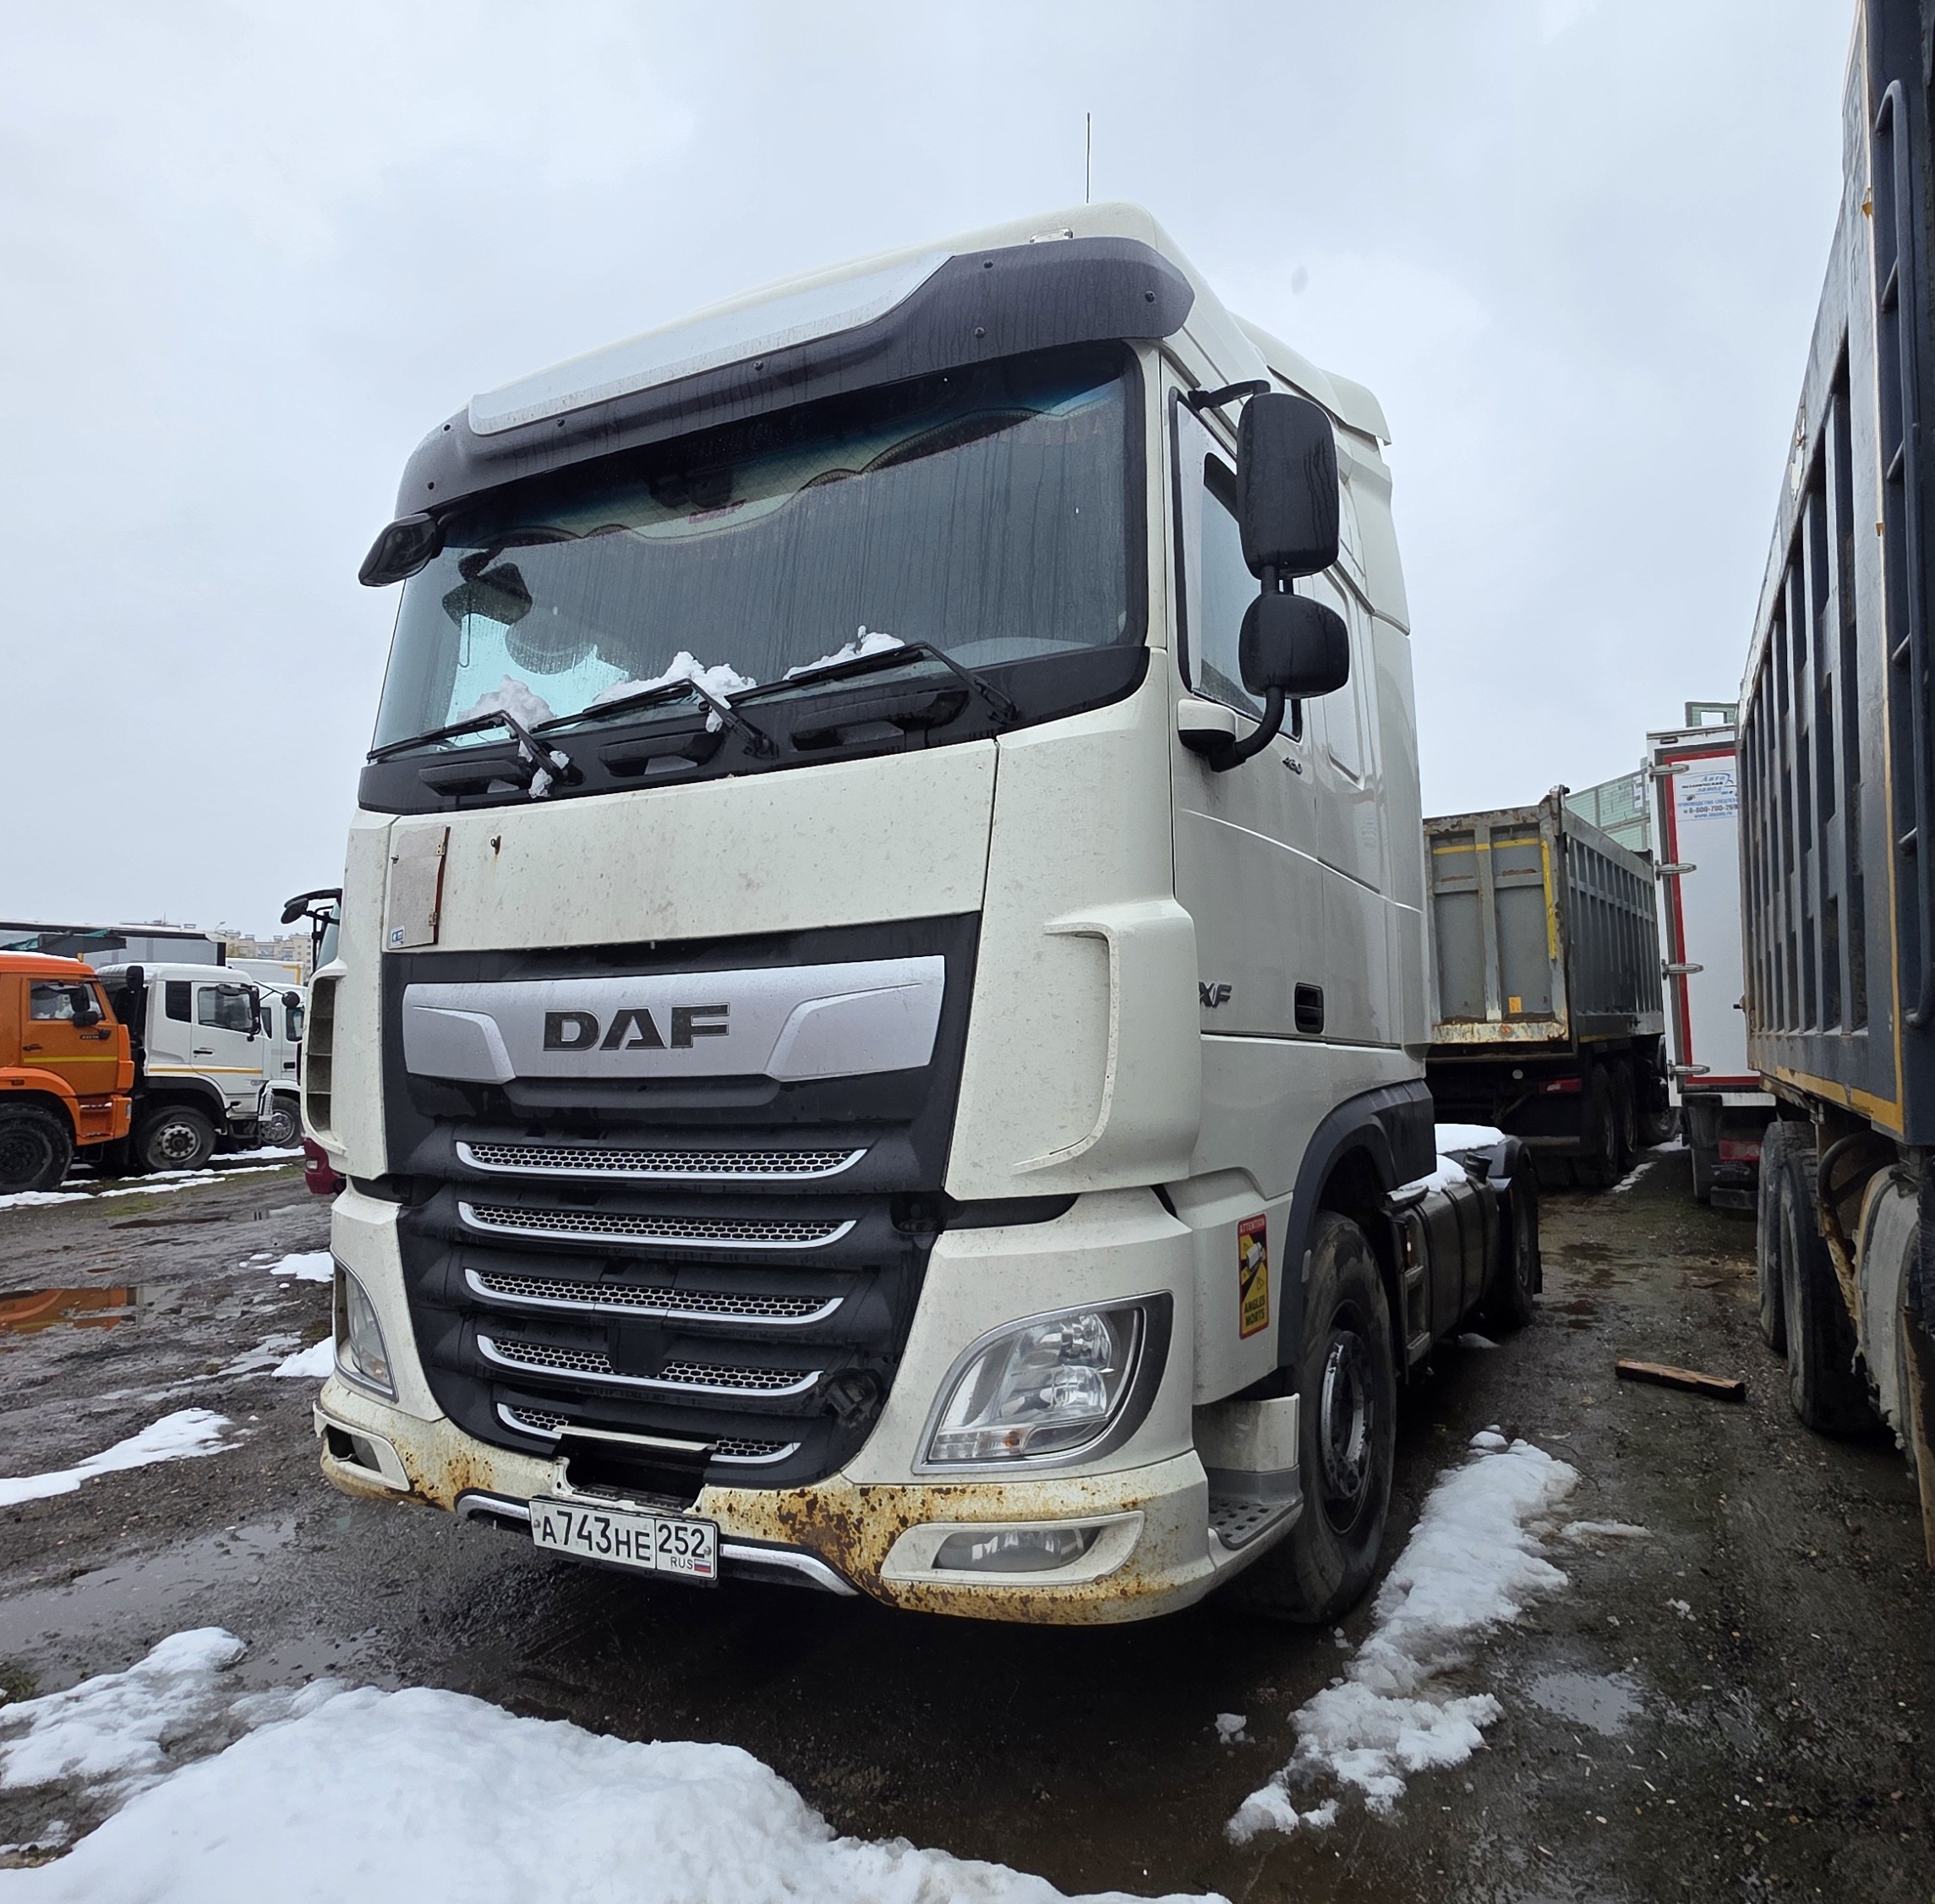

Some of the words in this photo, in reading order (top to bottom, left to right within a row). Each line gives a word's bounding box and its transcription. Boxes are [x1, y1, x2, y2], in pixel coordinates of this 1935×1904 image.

[1198, 981, 1232, 1008] XF
[544, 1003, 730, 1051] DAF
[1244, 1294, 1265, 1313] ANGLES
[1245, 1308, 1265, 1327] MORTS
[658, 1524, 705, 1558] 252
[670, 1557, 693, 1569] RUS
